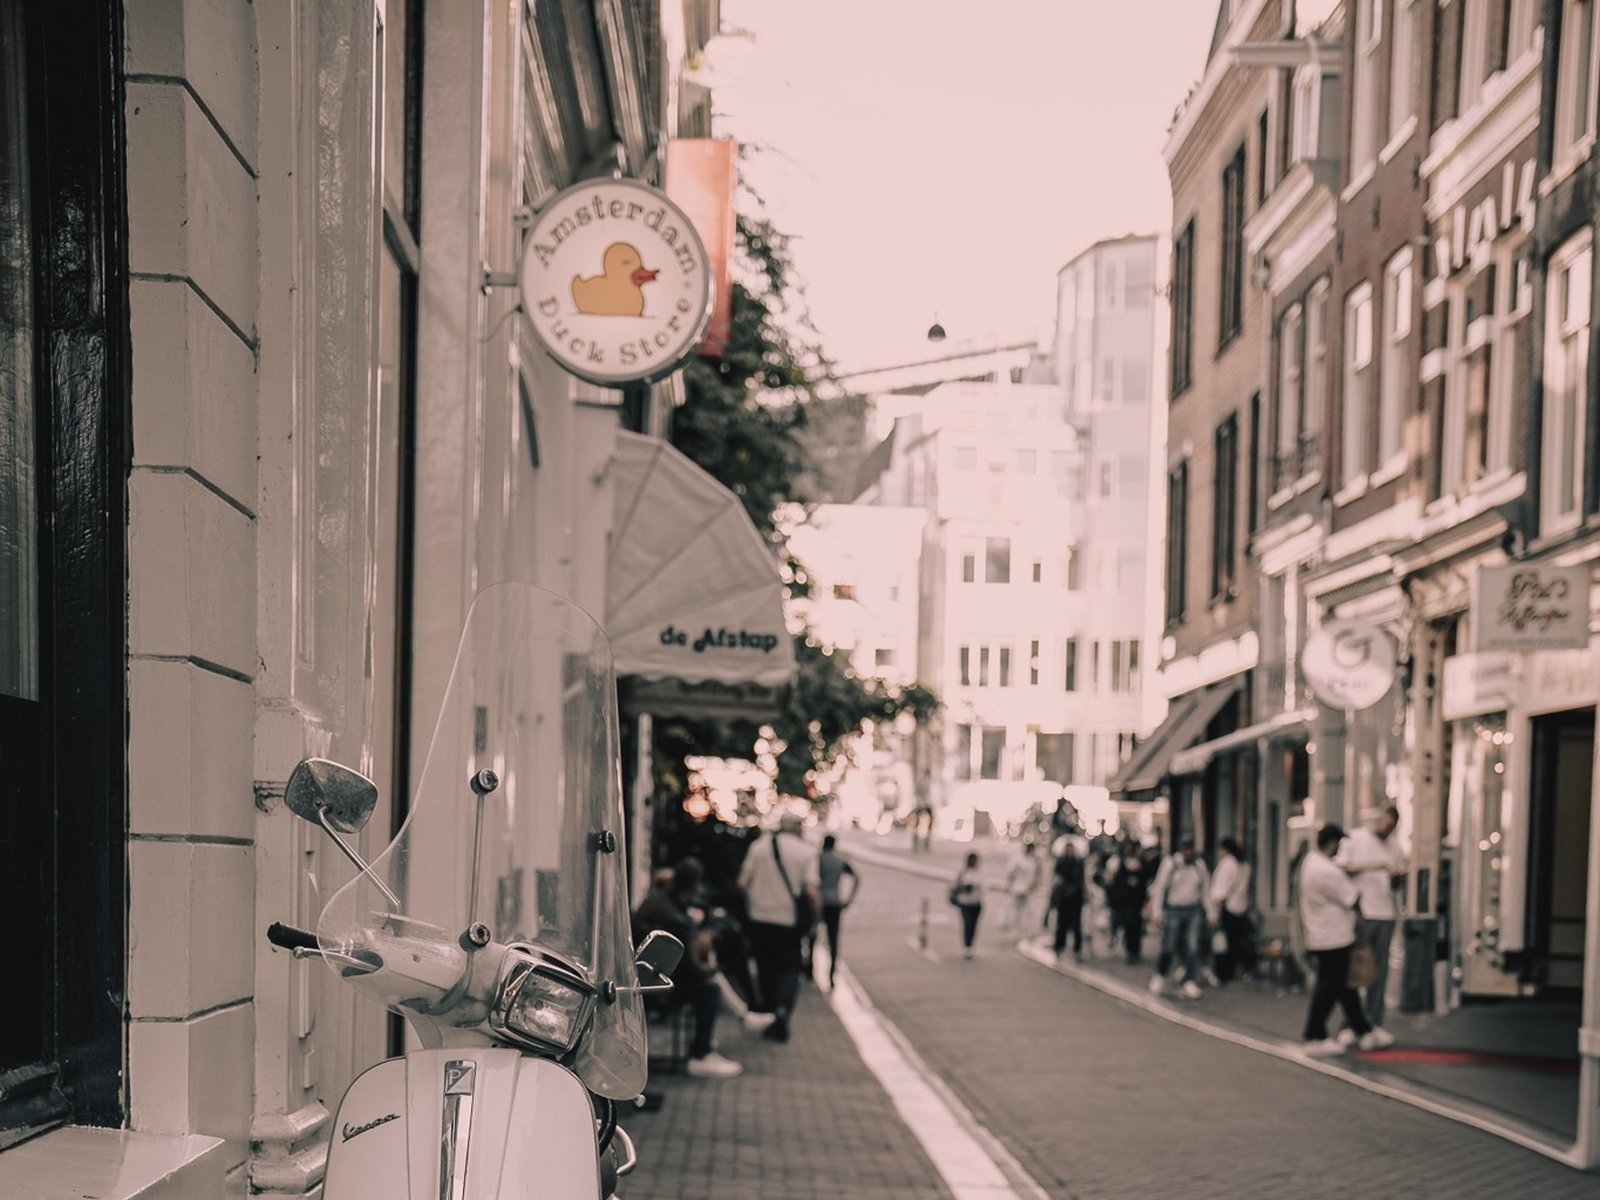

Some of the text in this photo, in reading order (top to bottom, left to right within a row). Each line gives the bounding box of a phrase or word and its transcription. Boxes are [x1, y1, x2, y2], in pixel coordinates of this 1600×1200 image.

[533, 195, 698, 274] Amsterdam
[537, 296, 693, 365] Duck Store
[660, 625, 778, 653] de Afstap
[342, 1112, 401, 1144] Vespa
